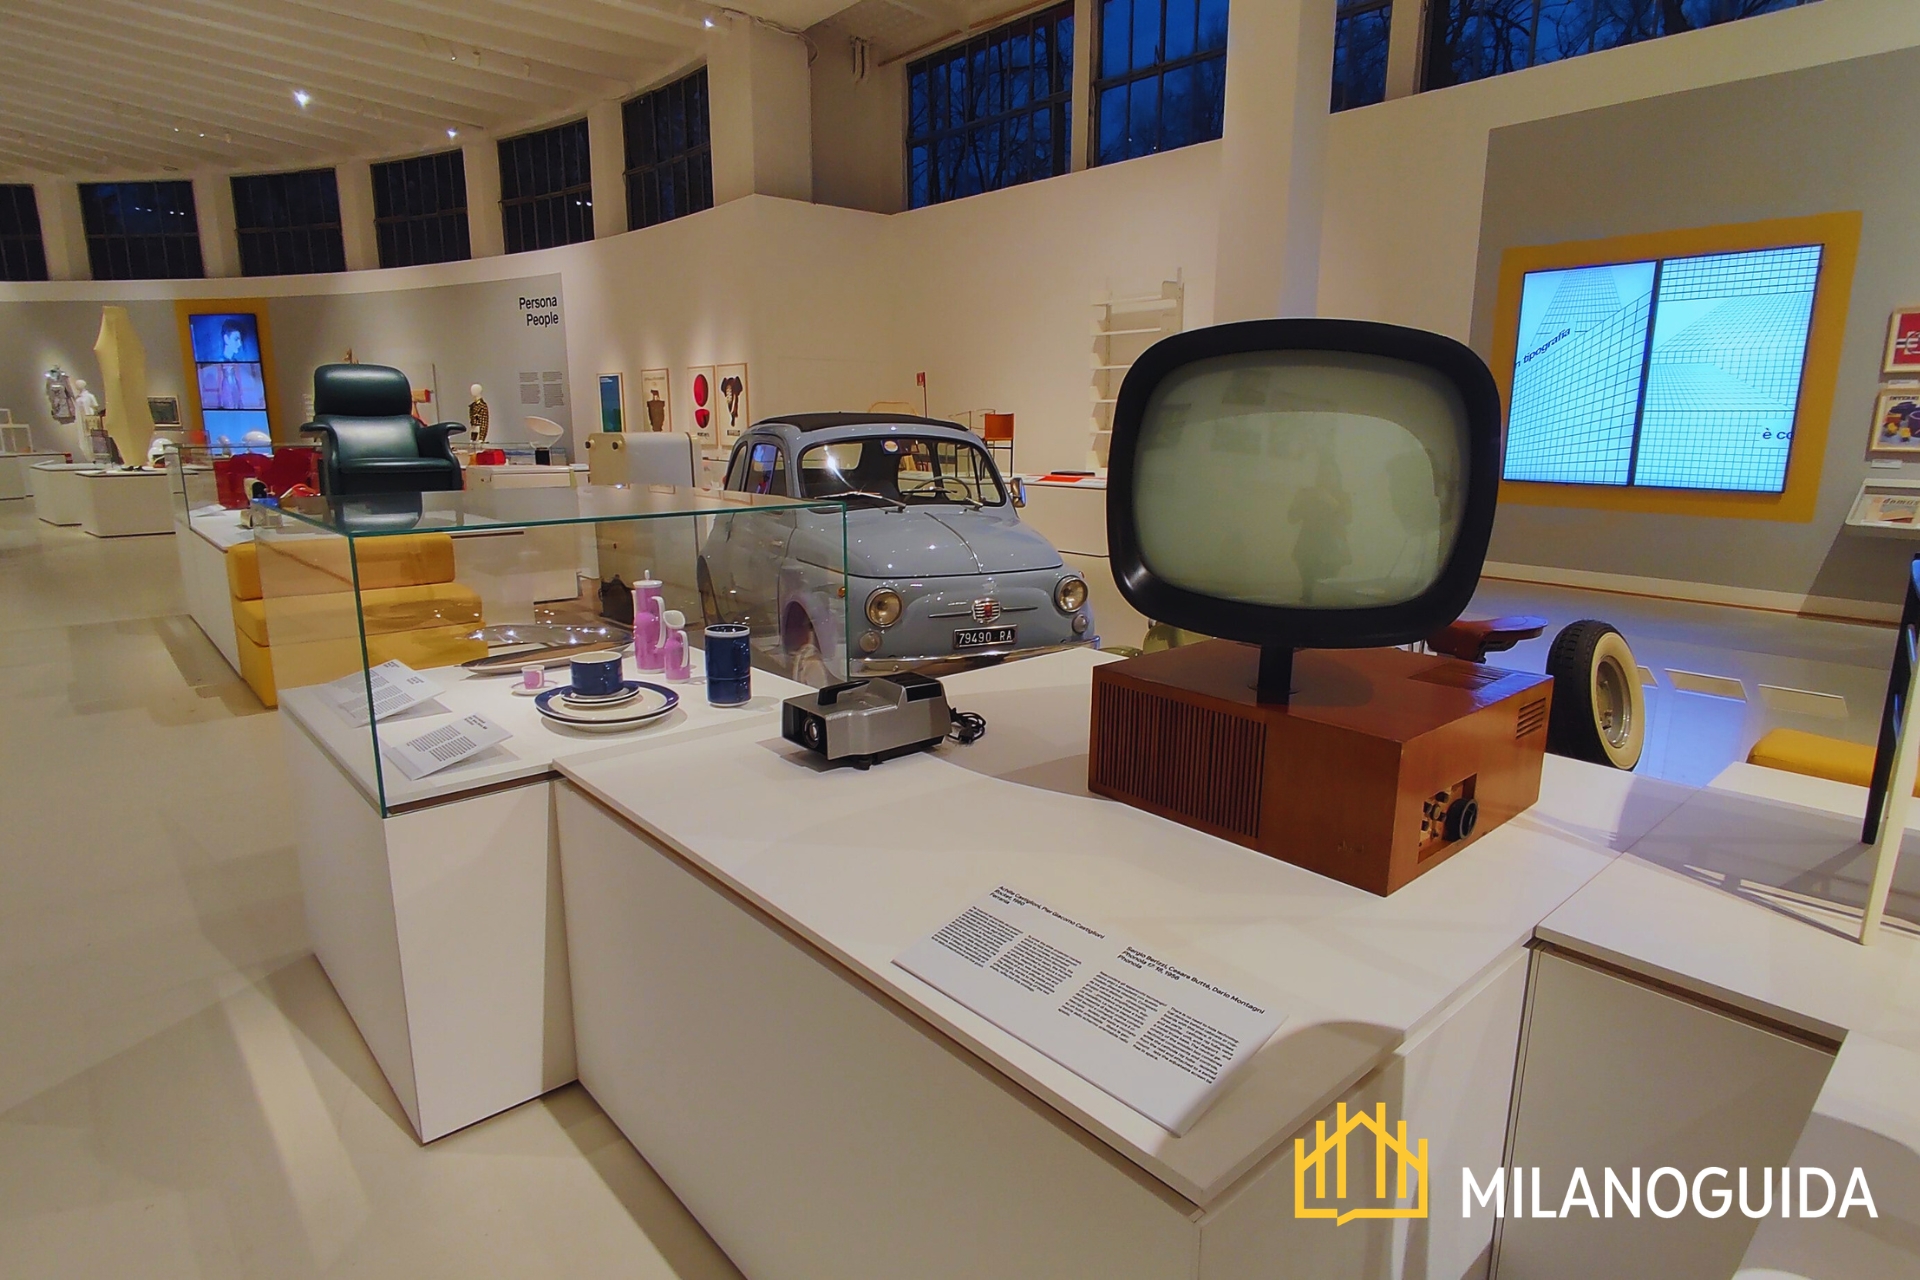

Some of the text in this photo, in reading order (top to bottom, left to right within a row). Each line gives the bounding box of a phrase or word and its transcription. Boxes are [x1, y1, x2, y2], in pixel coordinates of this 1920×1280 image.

[519, 296, 557, 310] Persona
[526, 312, 559, 328] People
[1523, 328, 1571, 364] tipografia
[1762, 427, 1772, 440] è
[959, 629, 1012, 645] 79490 RA
[1051, 911, 1075, 926] Giacomo
[1075, 922, 1105, 939] Castiglioni
[1117, 954, 1143, 970] Phonola
[1121, 950, 1147, 965] Phonola
[1126, 946, 1146, 960] Sergio
[1168, 966, 1191, 979] Cesare
[1211, 986, 1231, 999] Dario
[1230, 996, 1265, 1015] Montagni
